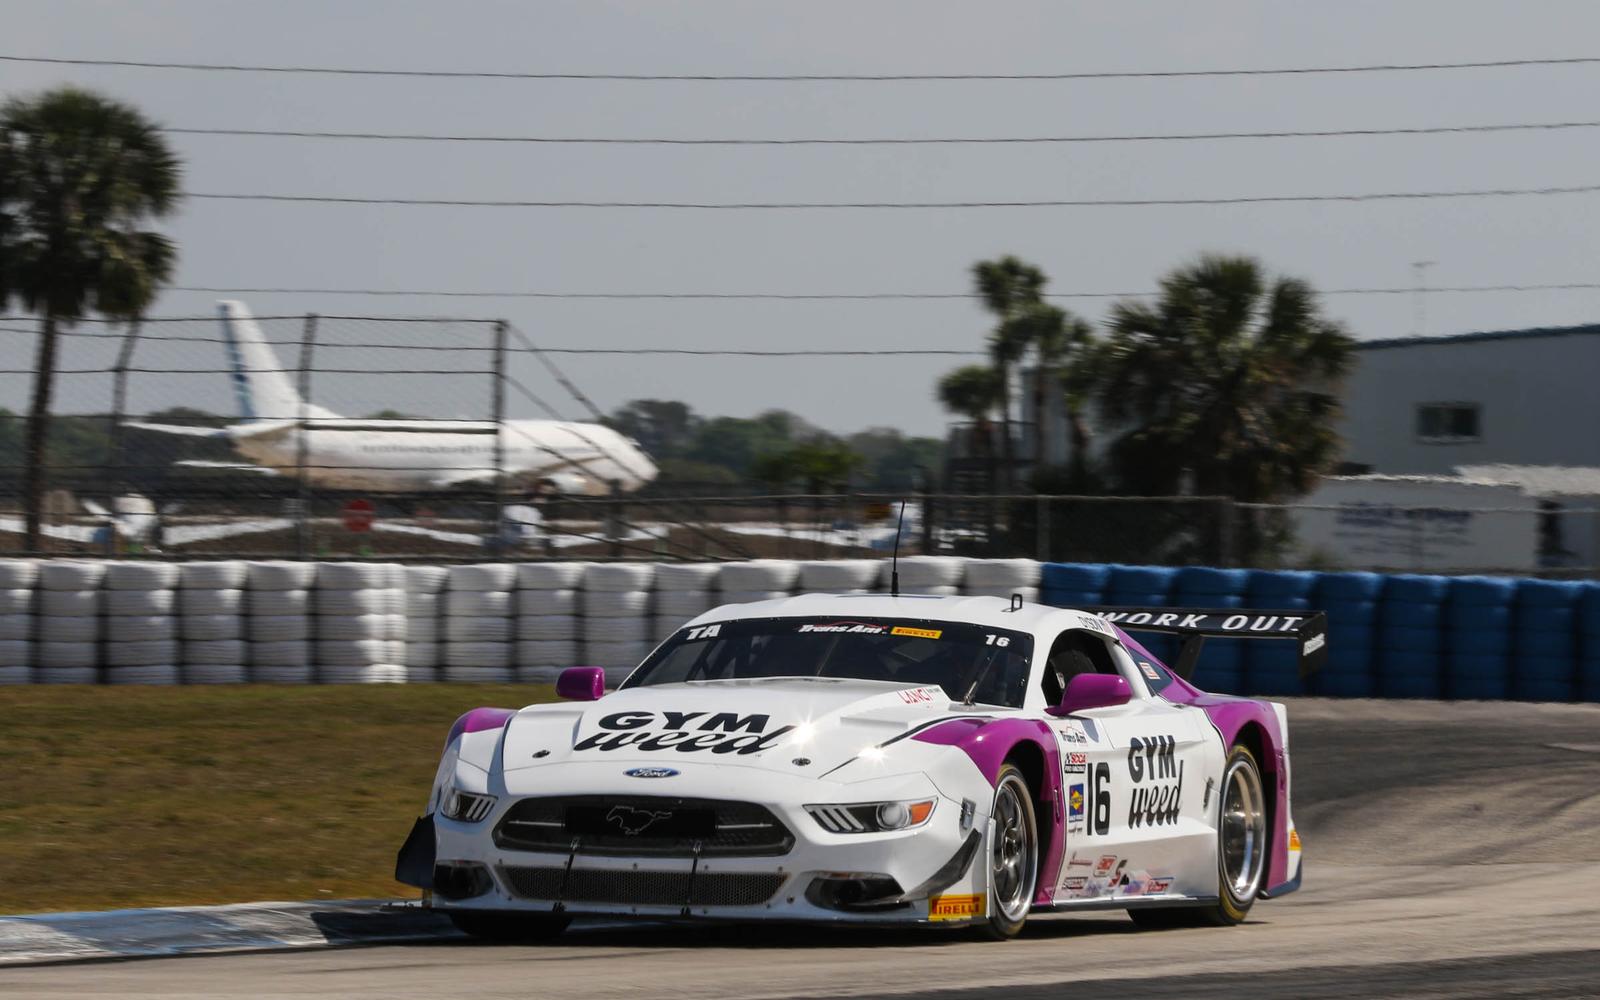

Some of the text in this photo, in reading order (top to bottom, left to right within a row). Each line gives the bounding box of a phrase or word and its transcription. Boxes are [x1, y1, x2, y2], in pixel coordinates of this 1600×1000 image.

[1097, 612, 1208, 627] WORK
[686, 624, 722, 640] TA
[895, 628, 937, 637] PIRELLI
[985, 634, 1010, 647] 16
[599, 712, 770, 733] GYM
[573, 725, 798, 755] weed
[1128, 735, 1177, 783] GYM
[1087, 762, 1111, 836] 16
[1128, 760, 1184, 830] weed
[932, 897, 980, 914] PIRELLI
